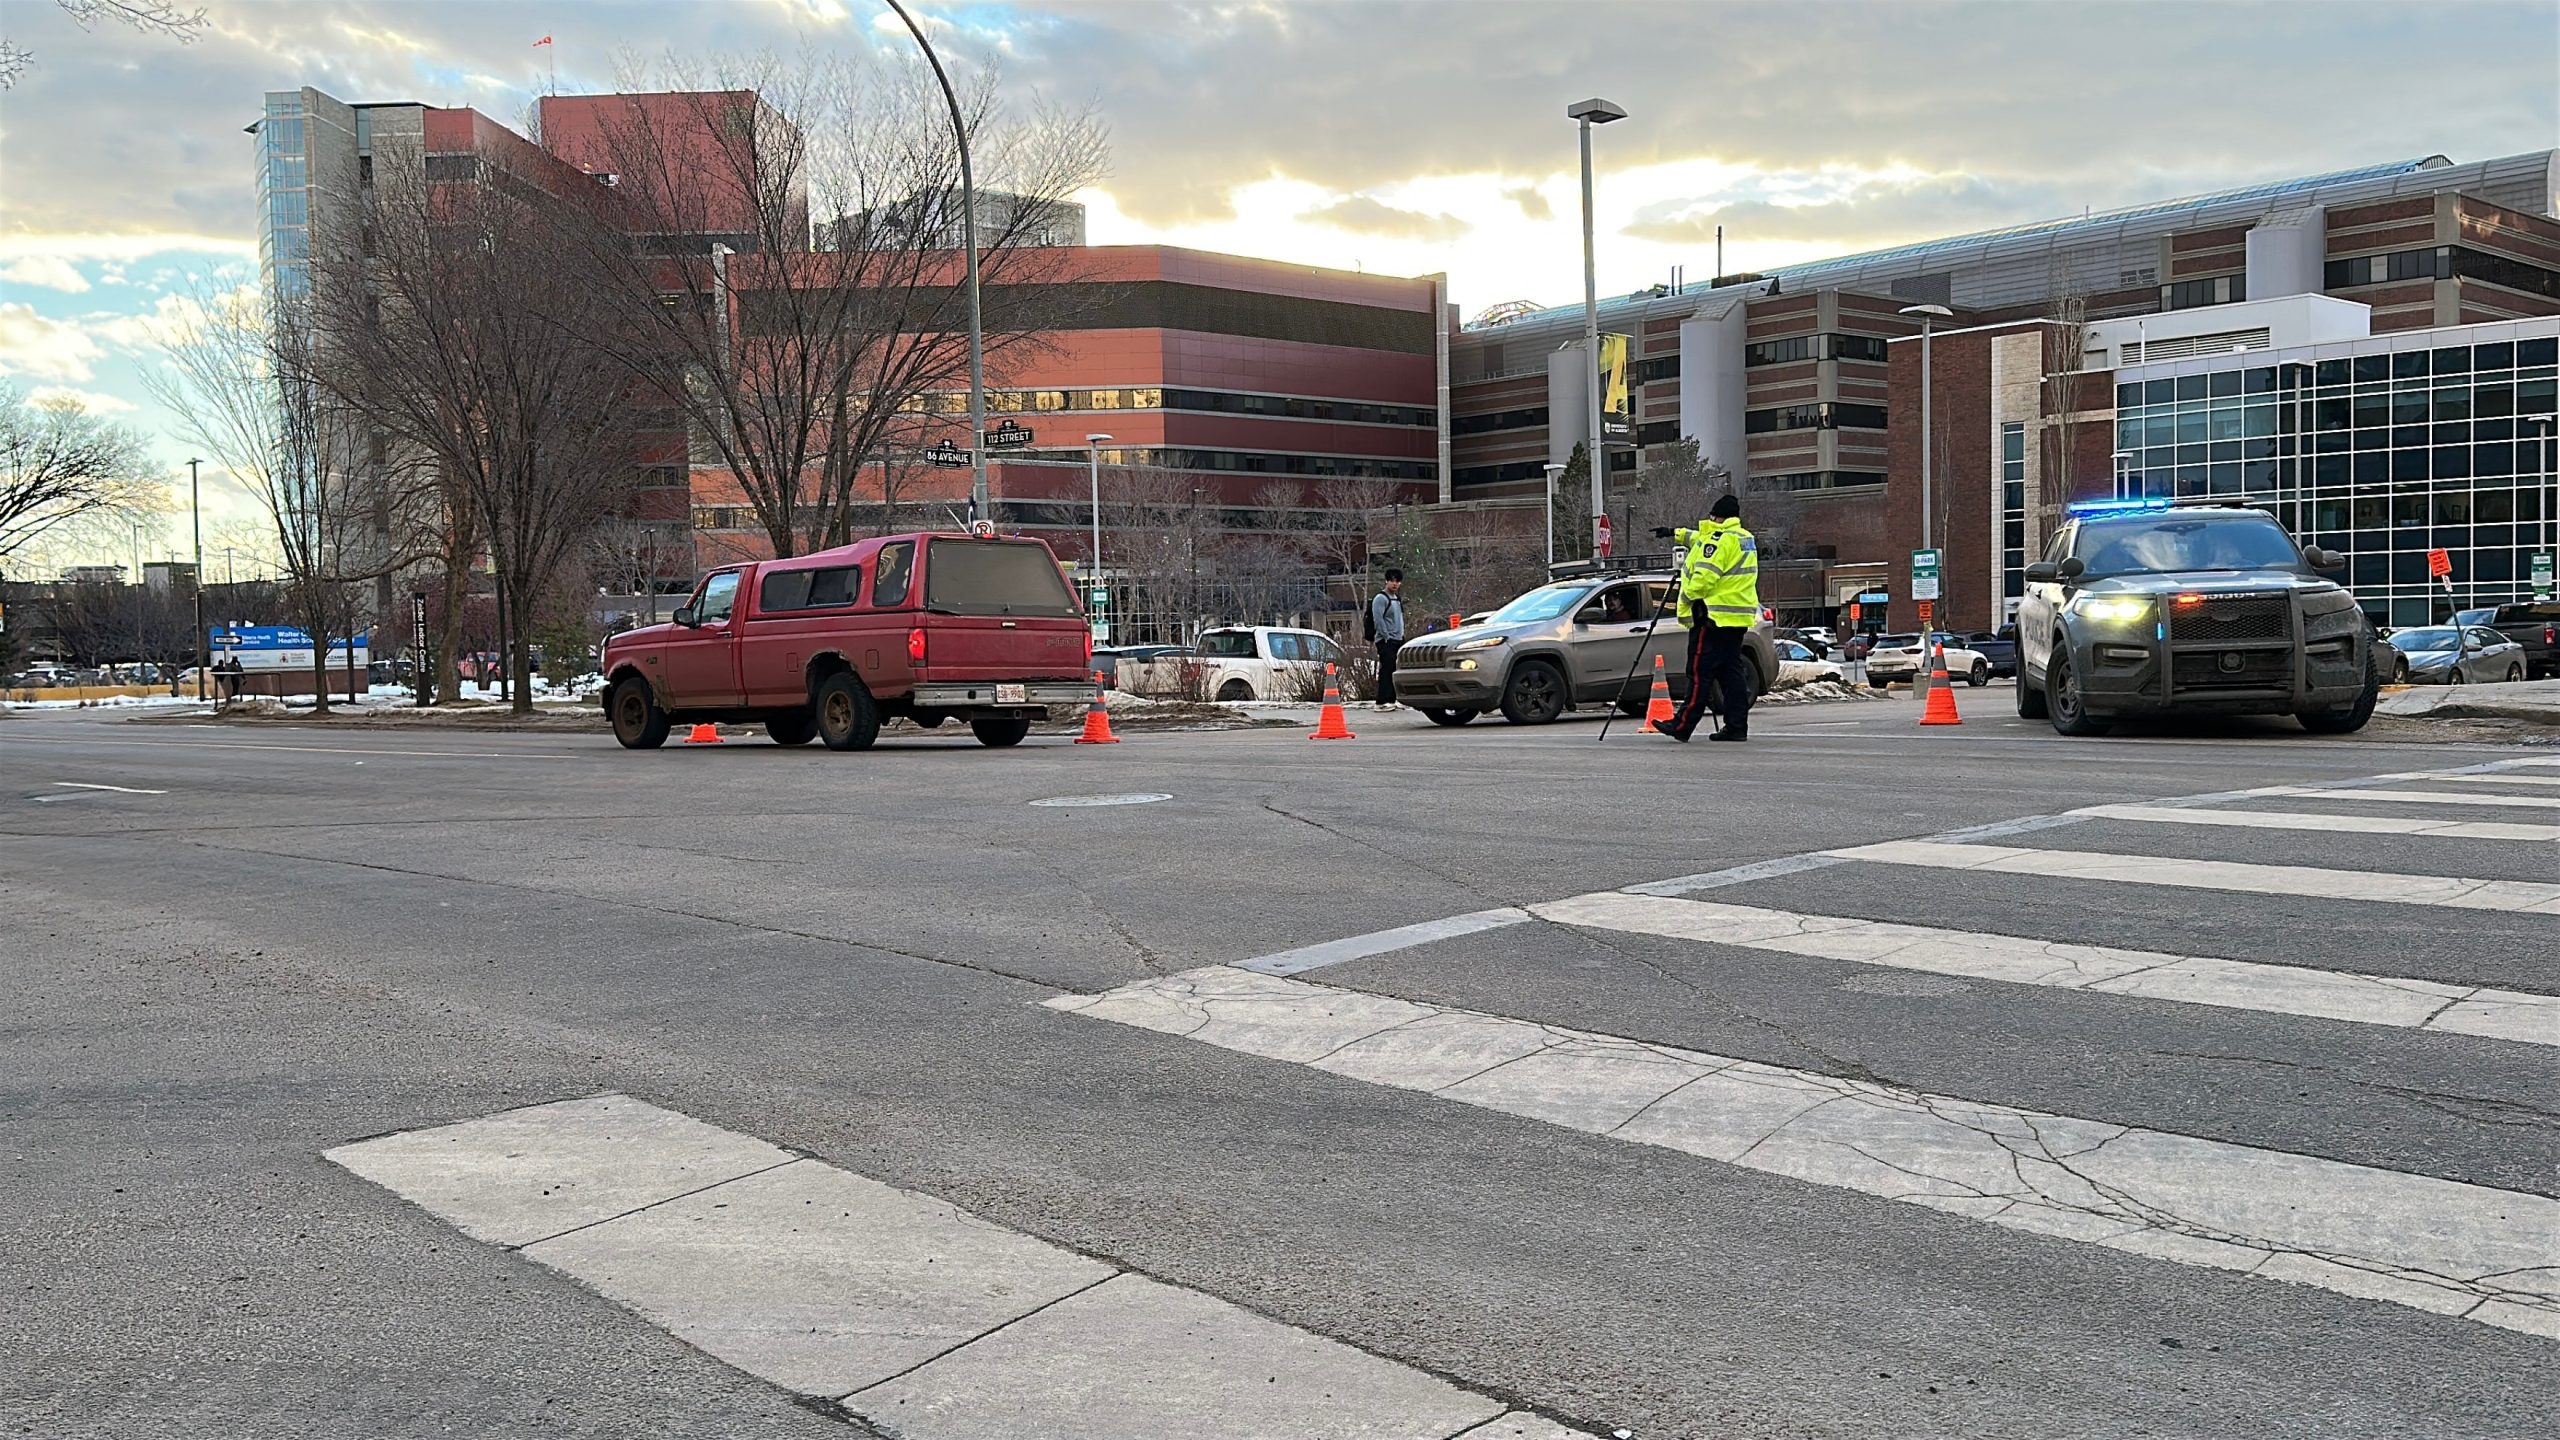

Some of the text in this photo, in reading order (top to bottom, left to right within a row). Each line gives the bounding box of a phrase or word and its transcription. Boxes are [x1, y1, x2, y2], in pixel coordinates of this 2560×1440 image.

[987, 431, 1030, 444] 112 STREET
[927, 451, 969, 463] 86 AVENUE
[1600, 527, 1610, 544] STOP
